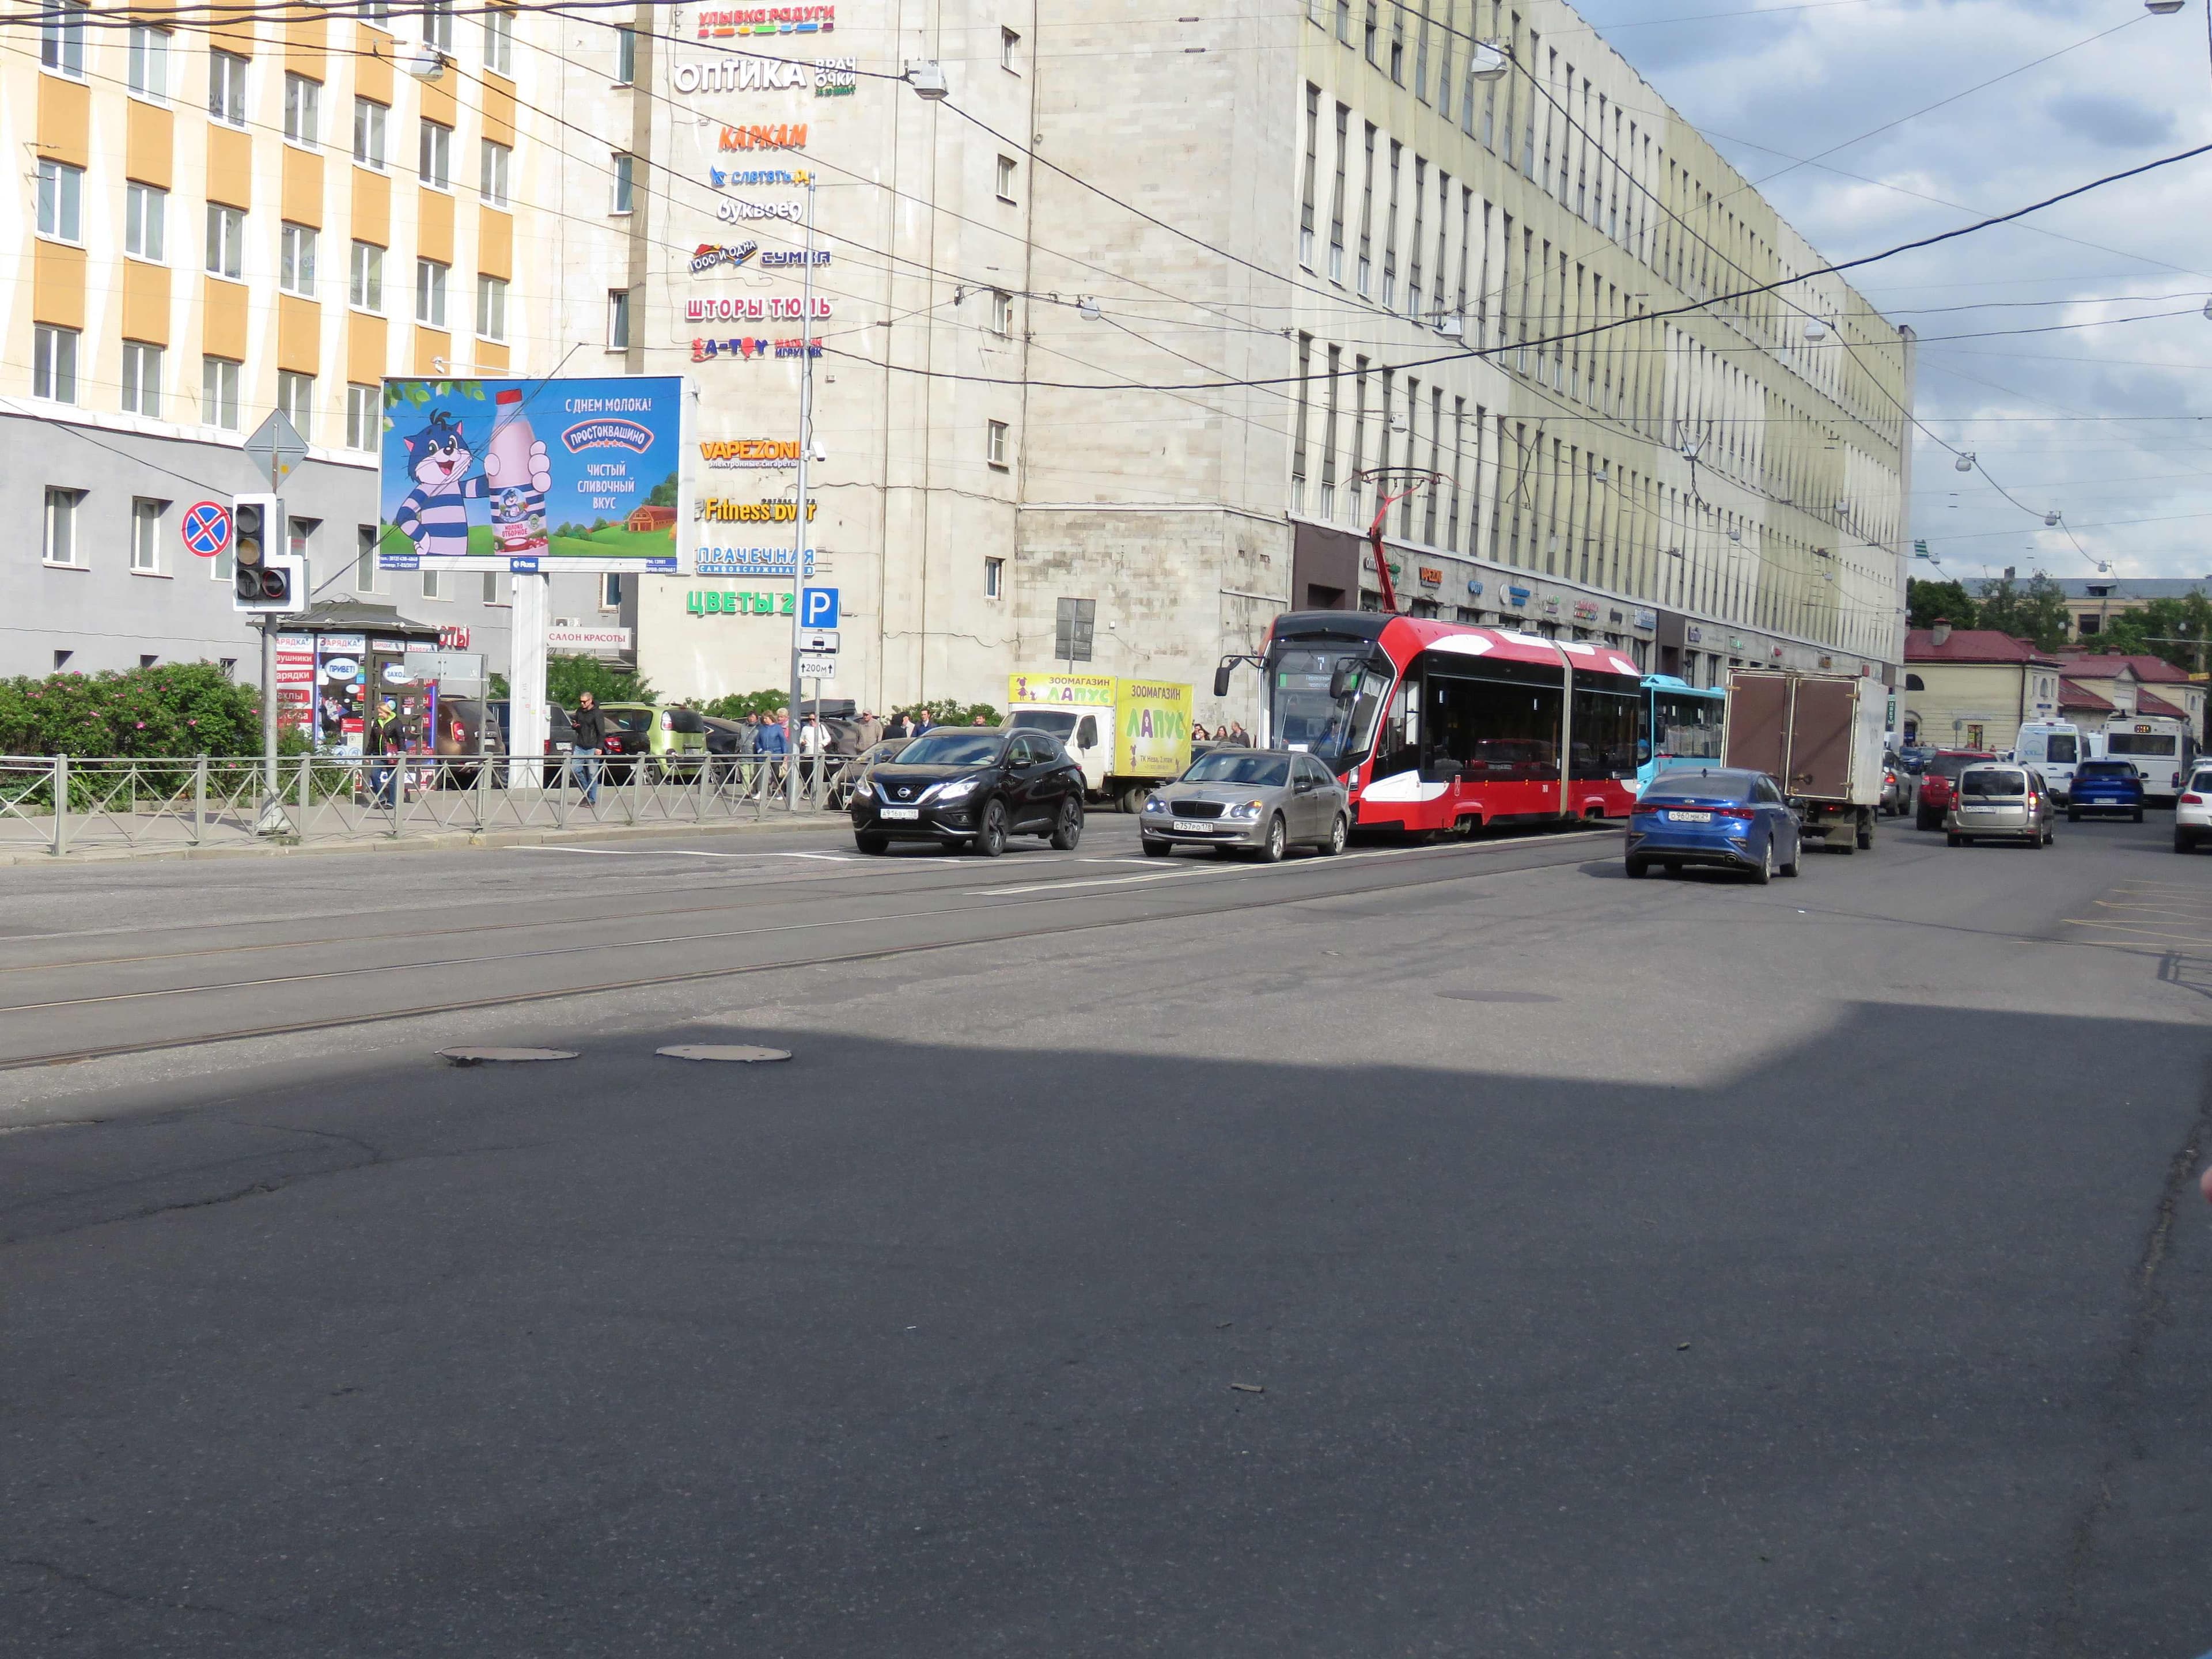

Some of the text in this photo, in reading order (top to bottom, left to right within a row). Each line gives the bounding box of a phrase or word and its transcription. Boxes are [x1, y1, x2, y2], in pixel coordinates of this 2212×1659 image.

[815, 57, 856, 74] ВРАЧ
[675, 60, 807, 92] ОПТИКА
[815, 73, 856, 87] ОЧКИ
[719, 123, 808, 150] КАРКАМ
[718, 249, 726, 261] И
[728, 240, 756, 257] ОДНА
[688, 298, 763, 317] ШТОРЫ
[565, 397, 652, 413] С ДНЕМ МОЛОКА!
[570, 425, 645, 446] ПРОСТОКВАШИНО
[586, 460, 626, 476] ЧИСТЫЙ
[577, 477, 635, 493] СЛИВОЧНЫЙ
[593, 497, 616, 509] ВКУС
[705, 498, 770, 521] Fitness
[699, 547, 814, 563] ПРАЧЕЧНАЯ
[687, 591, 774, 615] ЦВЕТЫ
[276, 638, 306, 646] АРЯДКА
[320, 637, 357, 646] ЗАРЯДКА
[549, 633, 626, 643] САЛОН КРАСОТЫ
[276, 672, 309, 681] арядки
[1049, 677, 1109, 686] ЗООМАГАЗИН
[1047, 687, 1109, 703] ЛАПУС
[1131, 685, 1181, 700] ЗООМАГАЗИН
[1126, 708, 1185, 740] ЛАПУС
